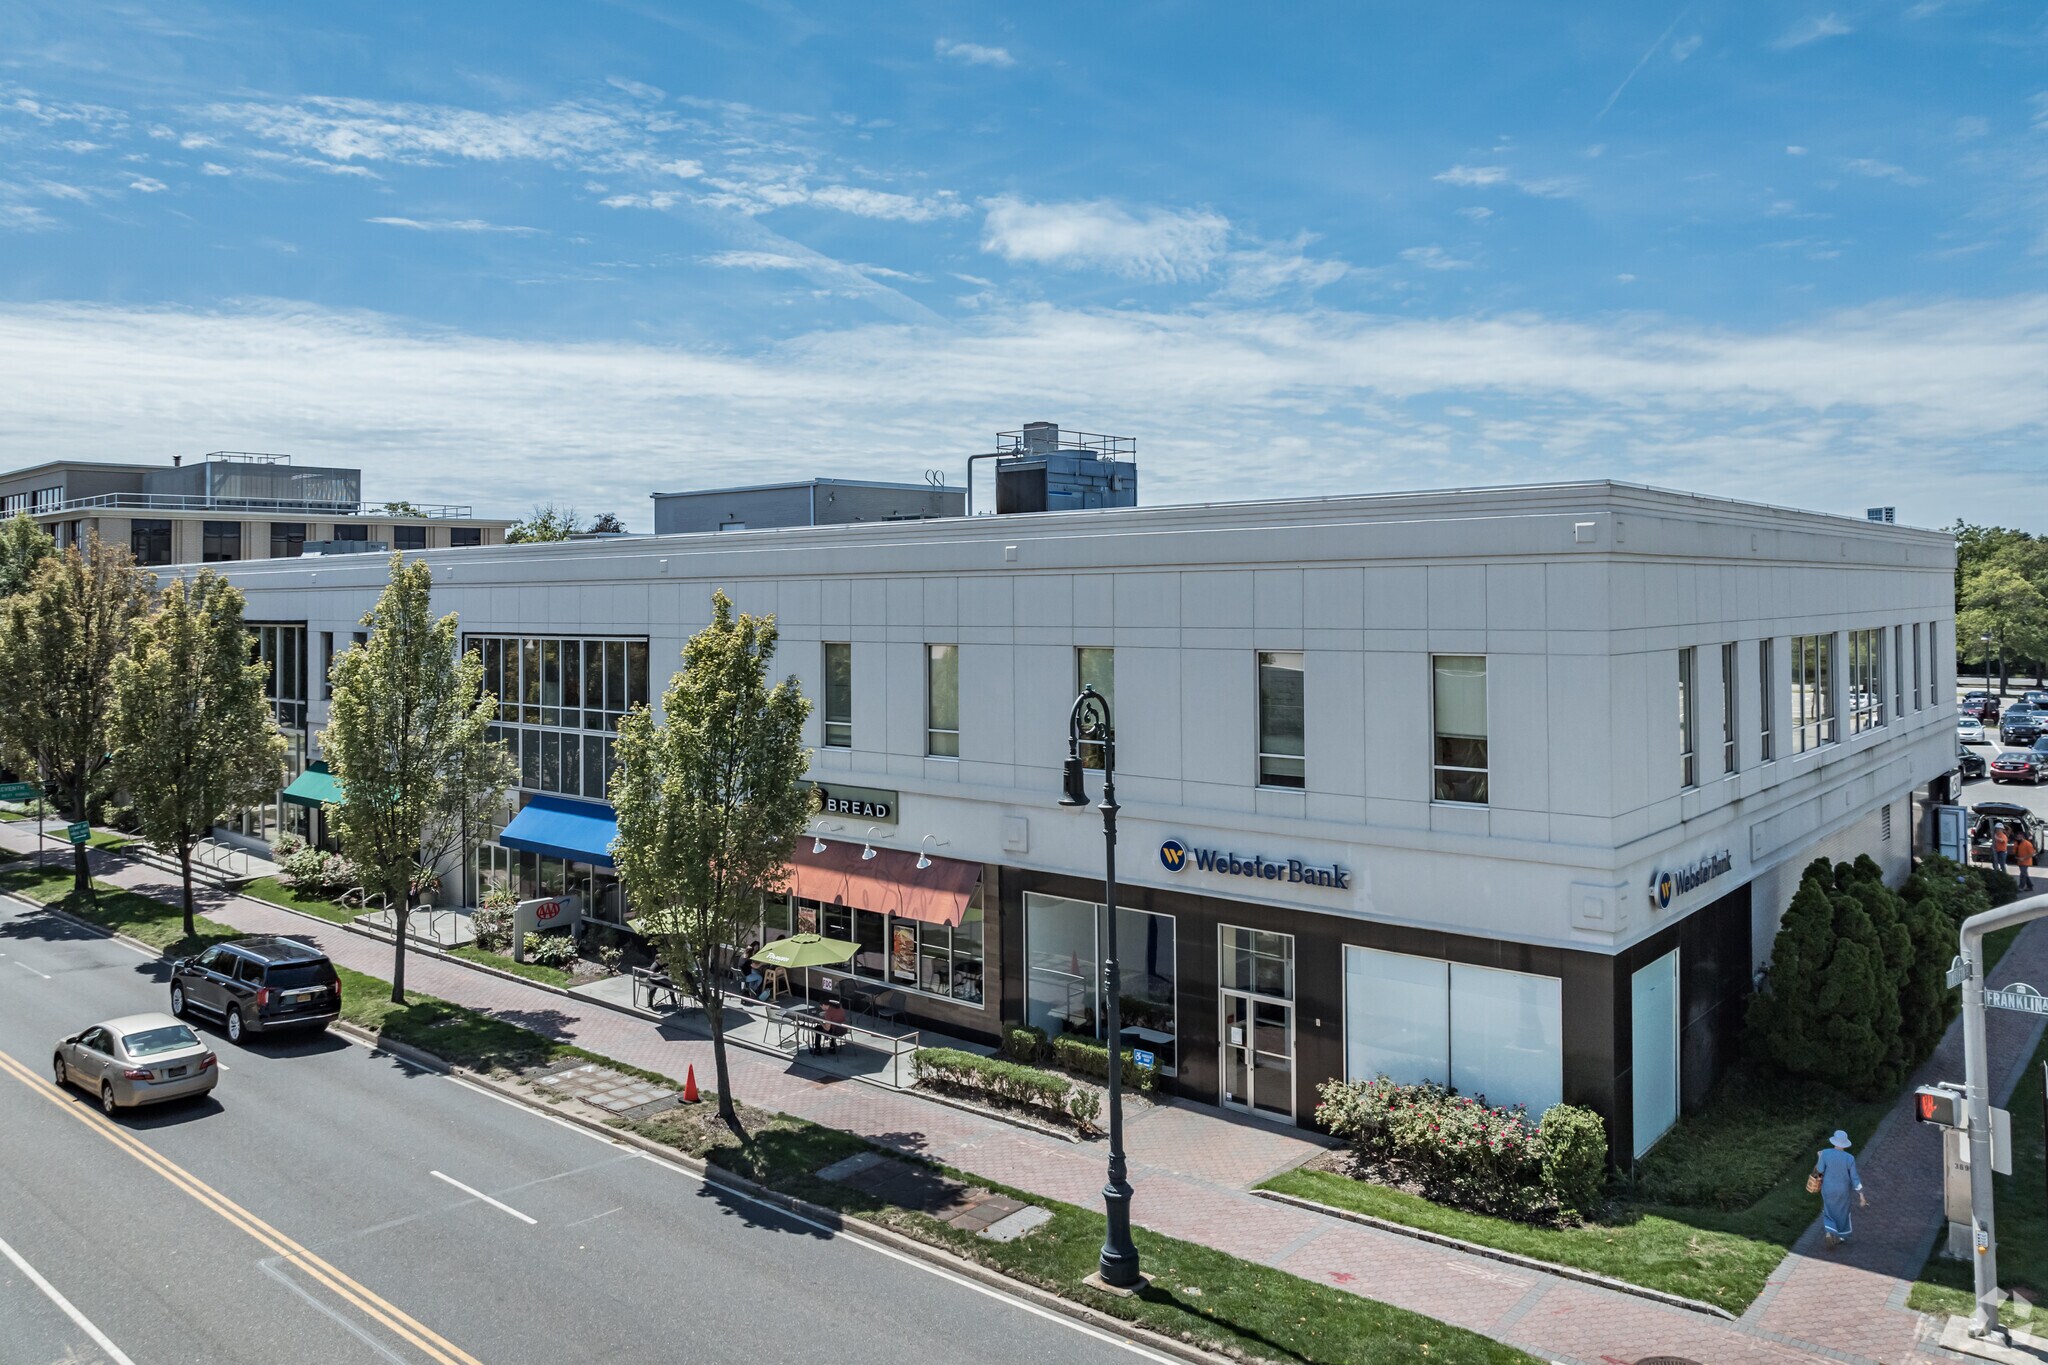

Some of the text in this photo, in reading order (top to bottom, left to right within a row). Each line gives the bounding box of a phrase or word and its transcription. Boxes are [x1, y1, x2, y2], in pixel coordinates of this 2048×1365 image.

[827, 798, 887, 818] BREAD
[537, 903, 559, 919] AAA
[1986, 991, 2042, 1013] FRANKLIN
